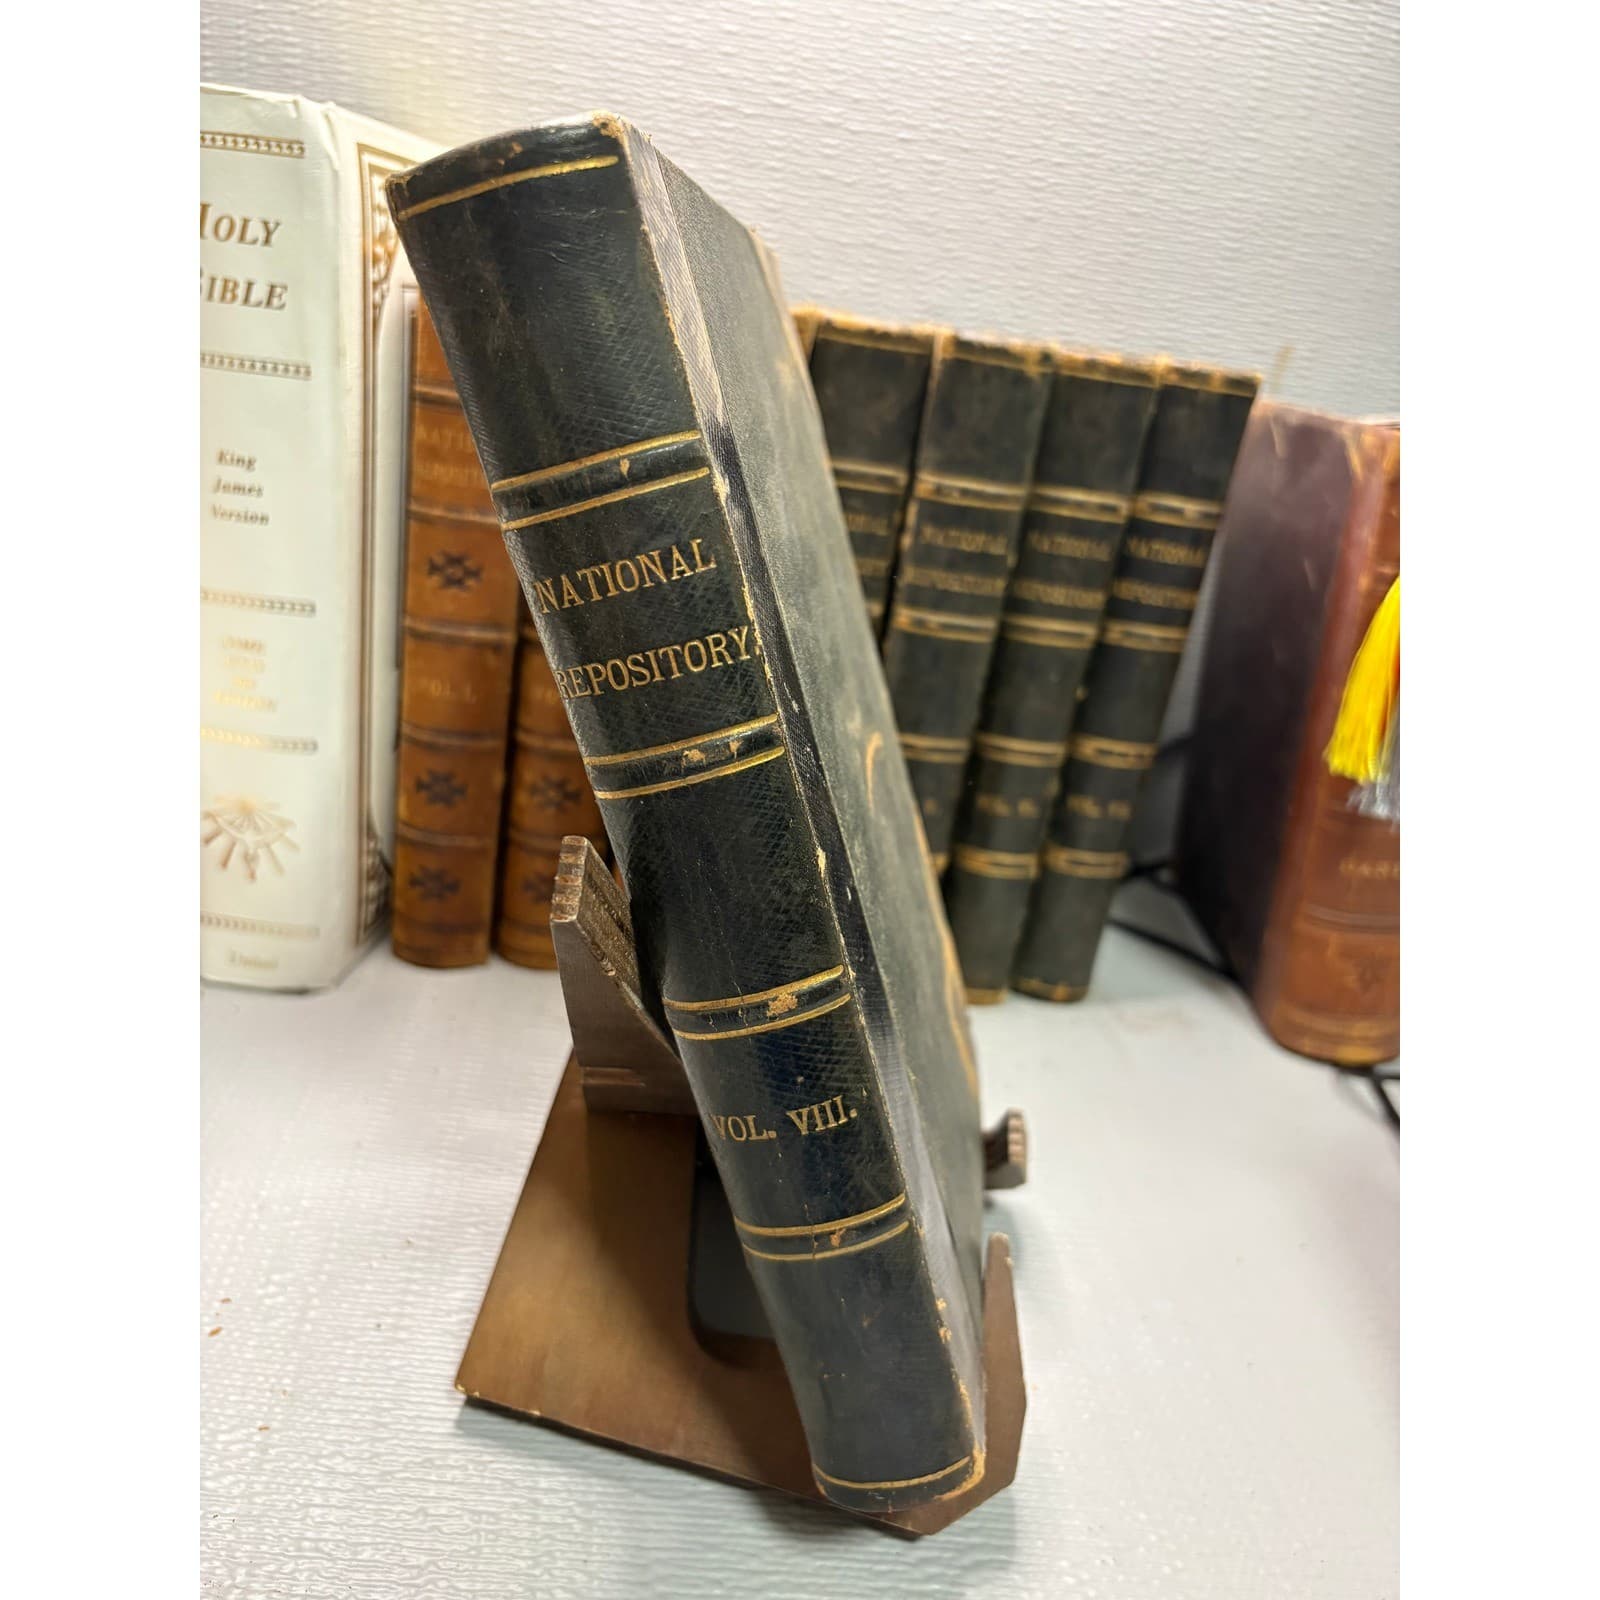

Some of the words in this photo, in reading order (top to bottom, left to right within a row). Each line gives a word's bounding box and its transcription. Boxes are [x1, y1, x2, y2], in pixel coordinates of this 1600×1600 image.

[200, 265, 288, 311] IBLE
[217, 448, 256, 472] King
[213, 477, 264, 498] James
[211, 503, 269, 526] Version
[532, 538, 717, 614] NATIONAL
[710, 1114, 777, 1141] VOL.
[786, 1095, 857, 1135] VIII.
